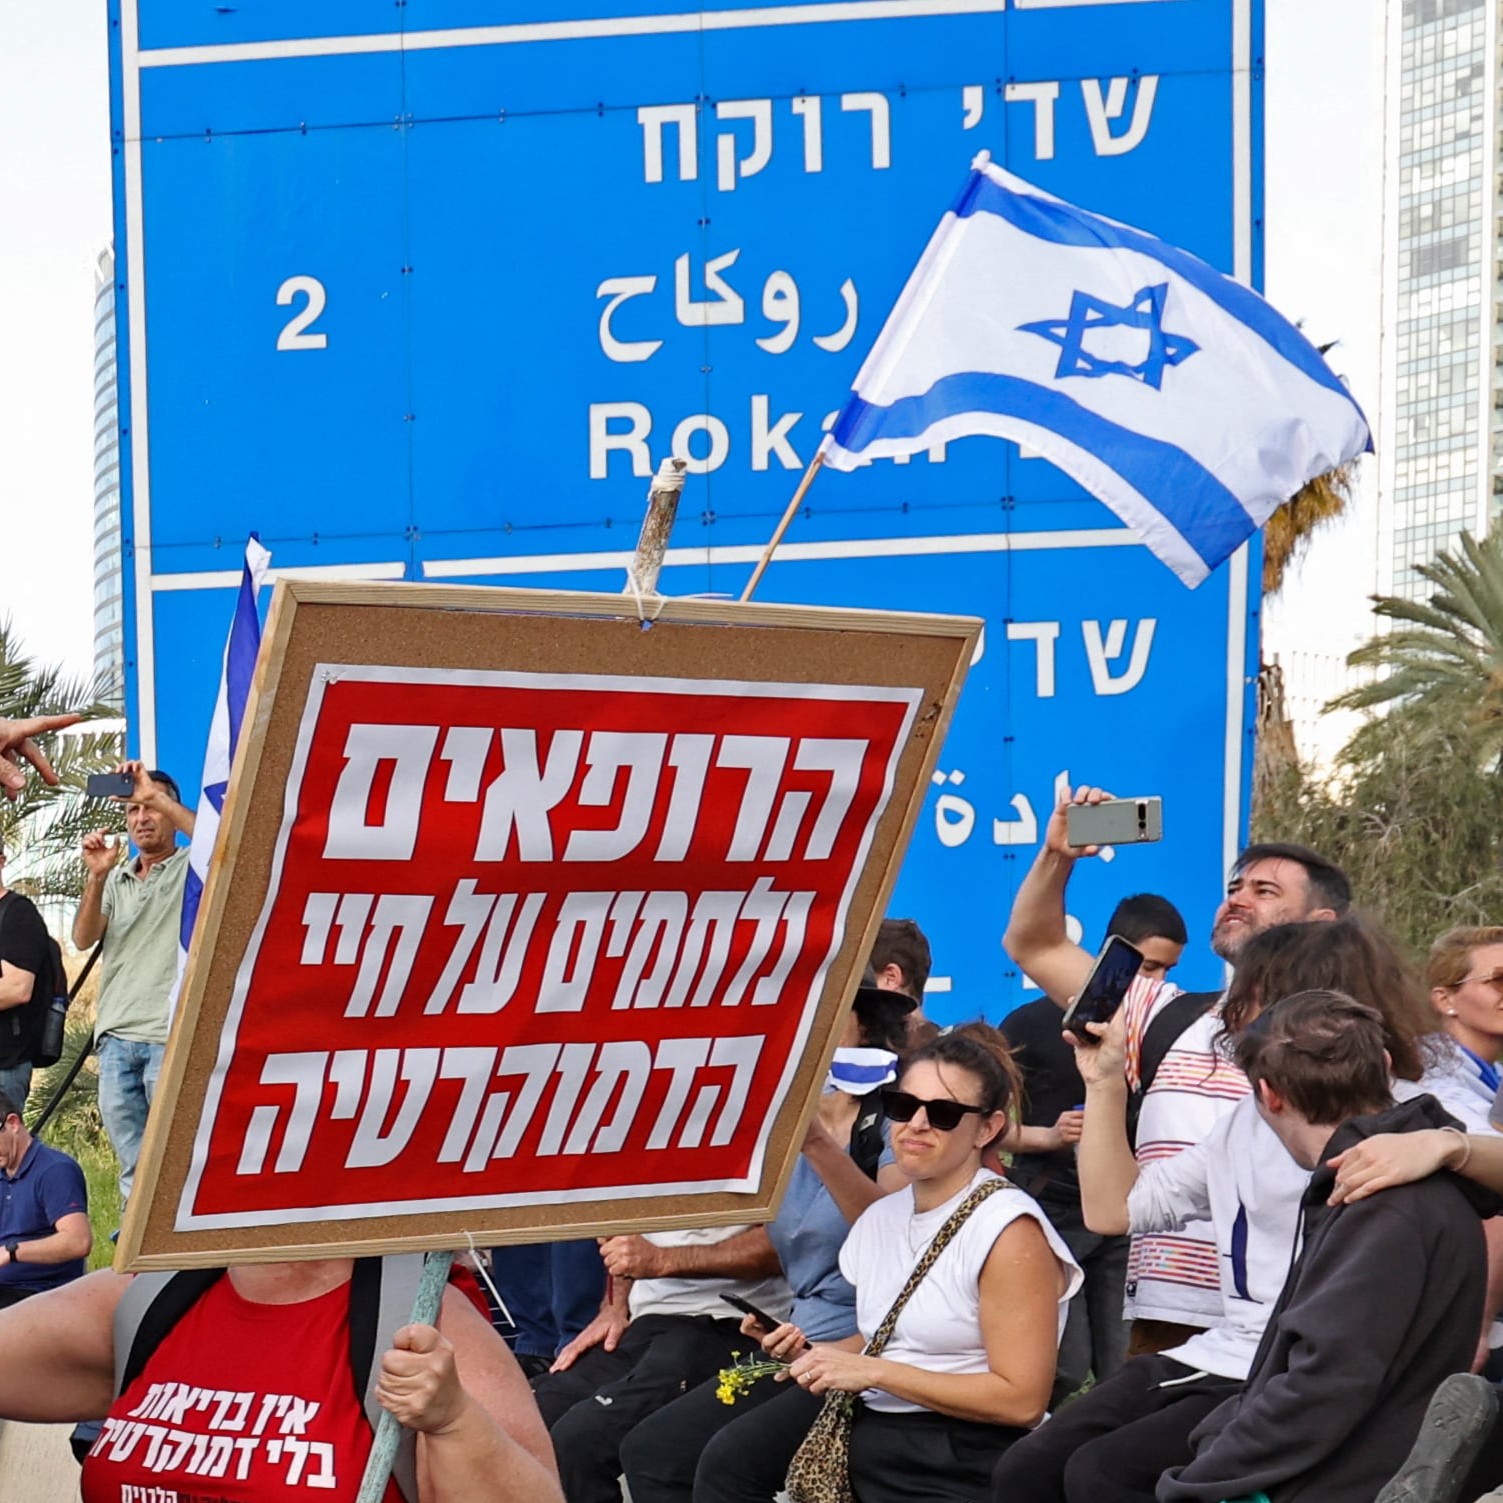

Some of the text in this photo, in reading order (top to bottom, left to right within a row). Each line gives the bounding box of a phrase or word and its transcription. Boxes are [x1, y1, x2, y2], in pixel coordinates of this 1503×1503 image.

[637, 93, 890, 192] רוקח
[276, 275, 327, 351] 2
[596, 249, 858, 362] روكاح
[321, 723, 870, 862] הרופאים
[300, 892, 435, 1018] חיי
[423, 878, 538, 1015] על
[534, 876, 817, 1014] נלחמים
[236, 1034, 766, 1175] הדמוקרטיה
[88, 1417, 337, 1489] בלי דמוקרטיה
[127, 1382, 320, 1436] אין בריאות
